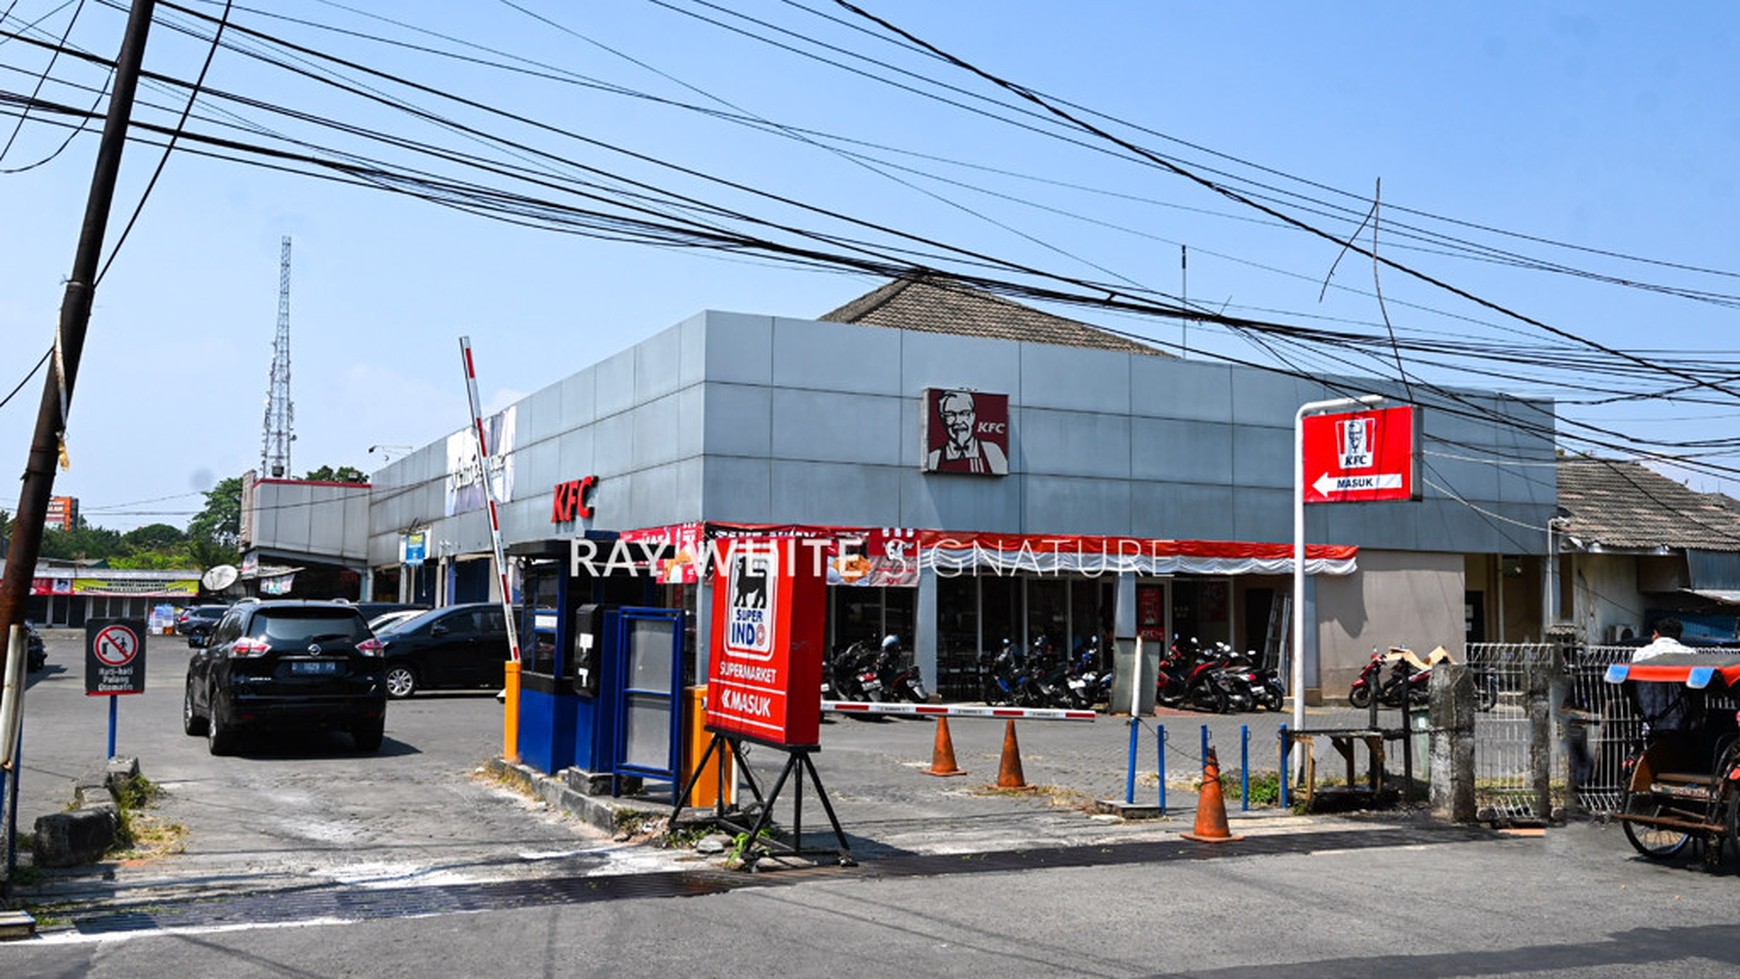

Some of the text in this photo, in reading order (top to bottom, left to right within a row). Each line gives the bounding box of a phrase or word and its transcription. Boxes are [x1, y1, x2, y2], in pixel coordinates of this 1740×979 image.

[977, 422, 1006, 434] KFC
[1344, 455, 1367, 466] KFC
[1336, 477, 1374, 489] MASUK
[551, 475, 599, 523] KFC
[736, 610, 763, 623] SUPER
[731, 623, 766, 646] INDO
[719, 661, 777, 683] SUPERMARKET
[730, 691, 771, 717] MASUK
